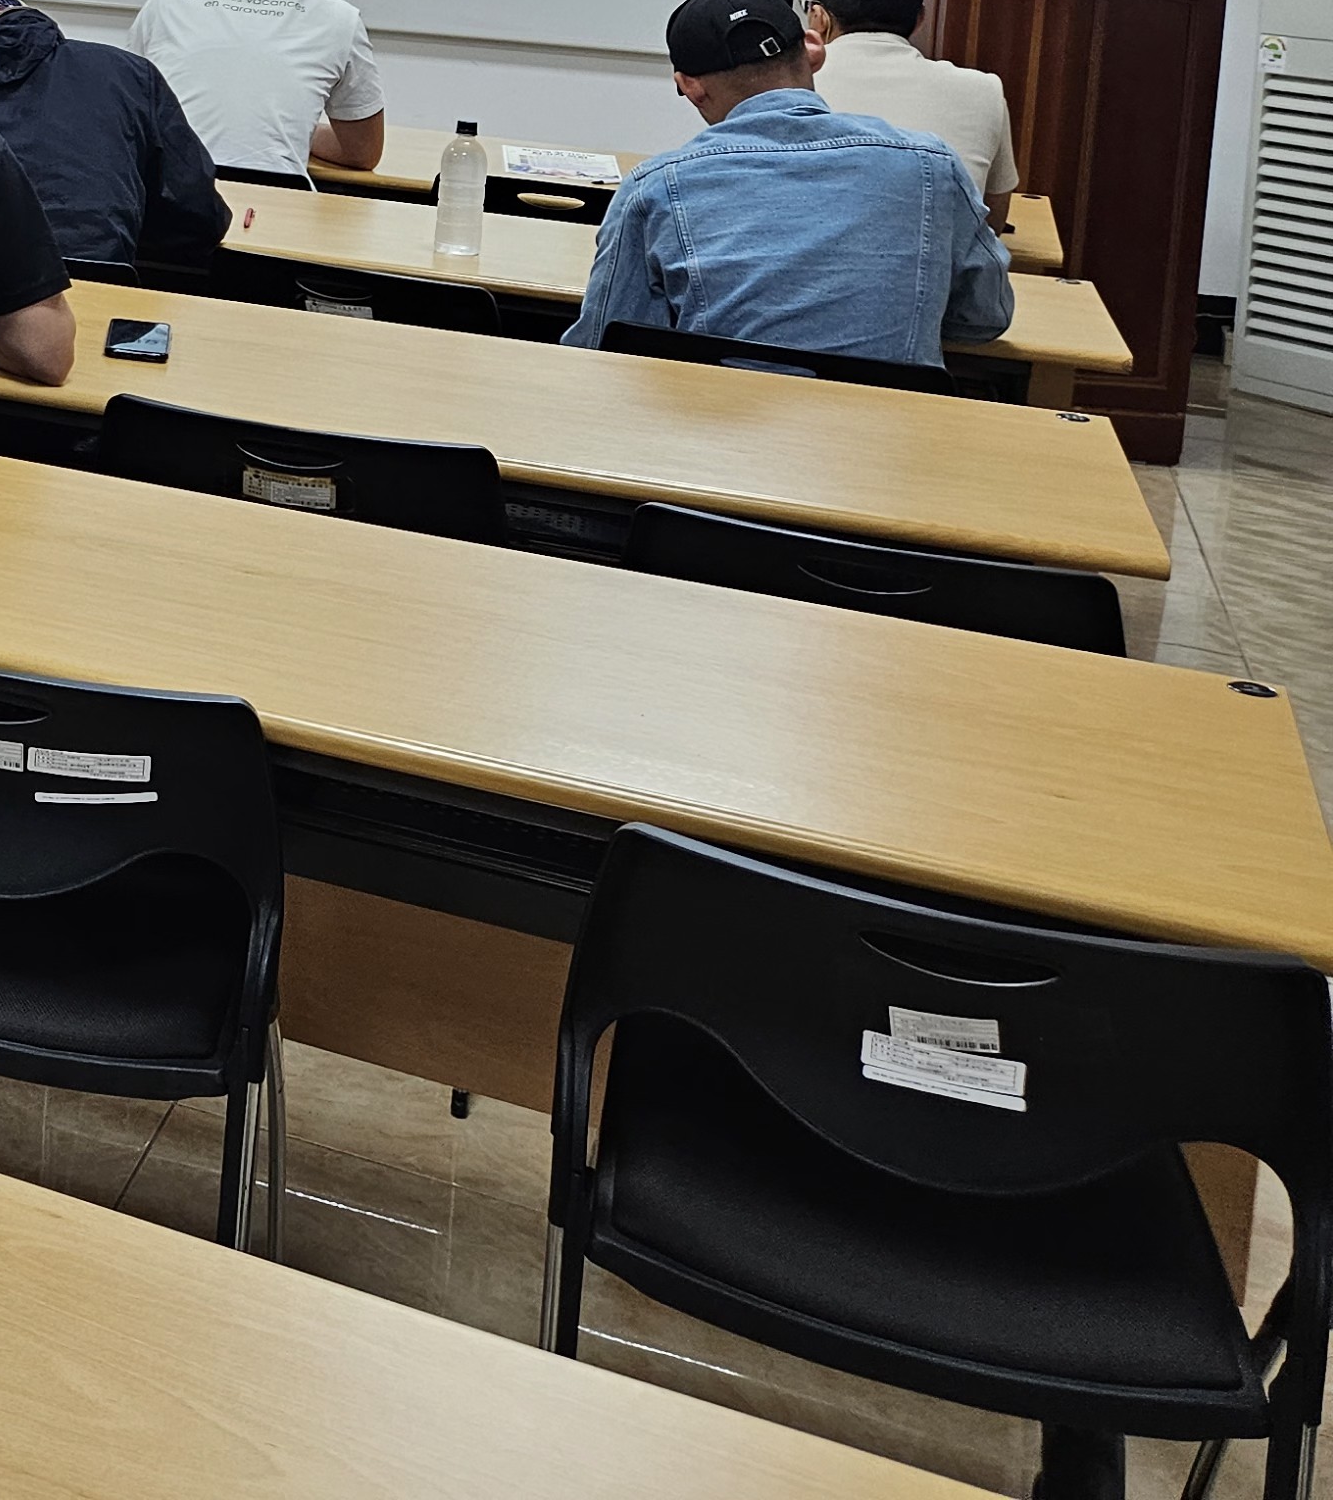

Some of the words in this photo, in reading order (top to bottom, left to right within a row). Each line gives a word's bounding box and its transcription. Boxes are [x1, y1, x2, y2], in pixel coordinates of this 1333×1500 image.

[204, 0, 219, 8] en
[222, 3, 285, 17] caravane
[729, 8, 749, 21] NIKE
